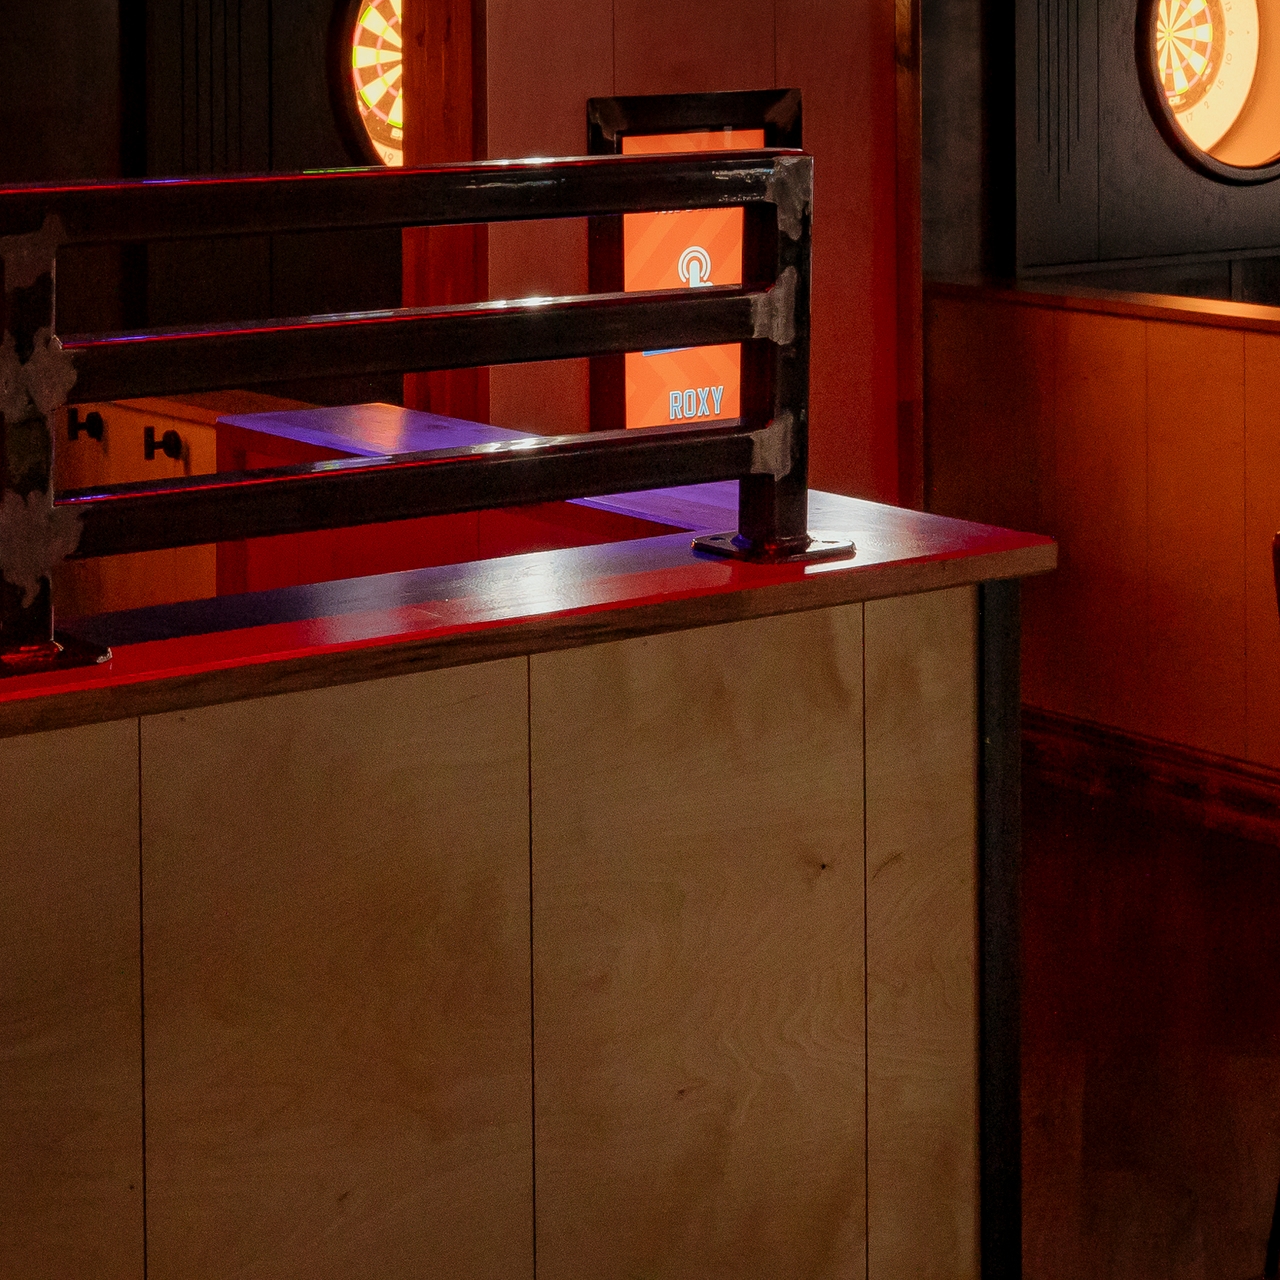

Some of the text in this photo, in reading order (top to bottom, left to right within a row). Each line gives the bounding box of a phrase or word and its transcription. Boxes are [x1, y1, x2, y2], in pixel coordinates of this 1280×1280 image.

[1224, 2, 1233, 12] 13
[1224, 53, 1233, 66] 10
[383, 151, 395, 163] 19
[669, 386, 724, 419] ROXY
